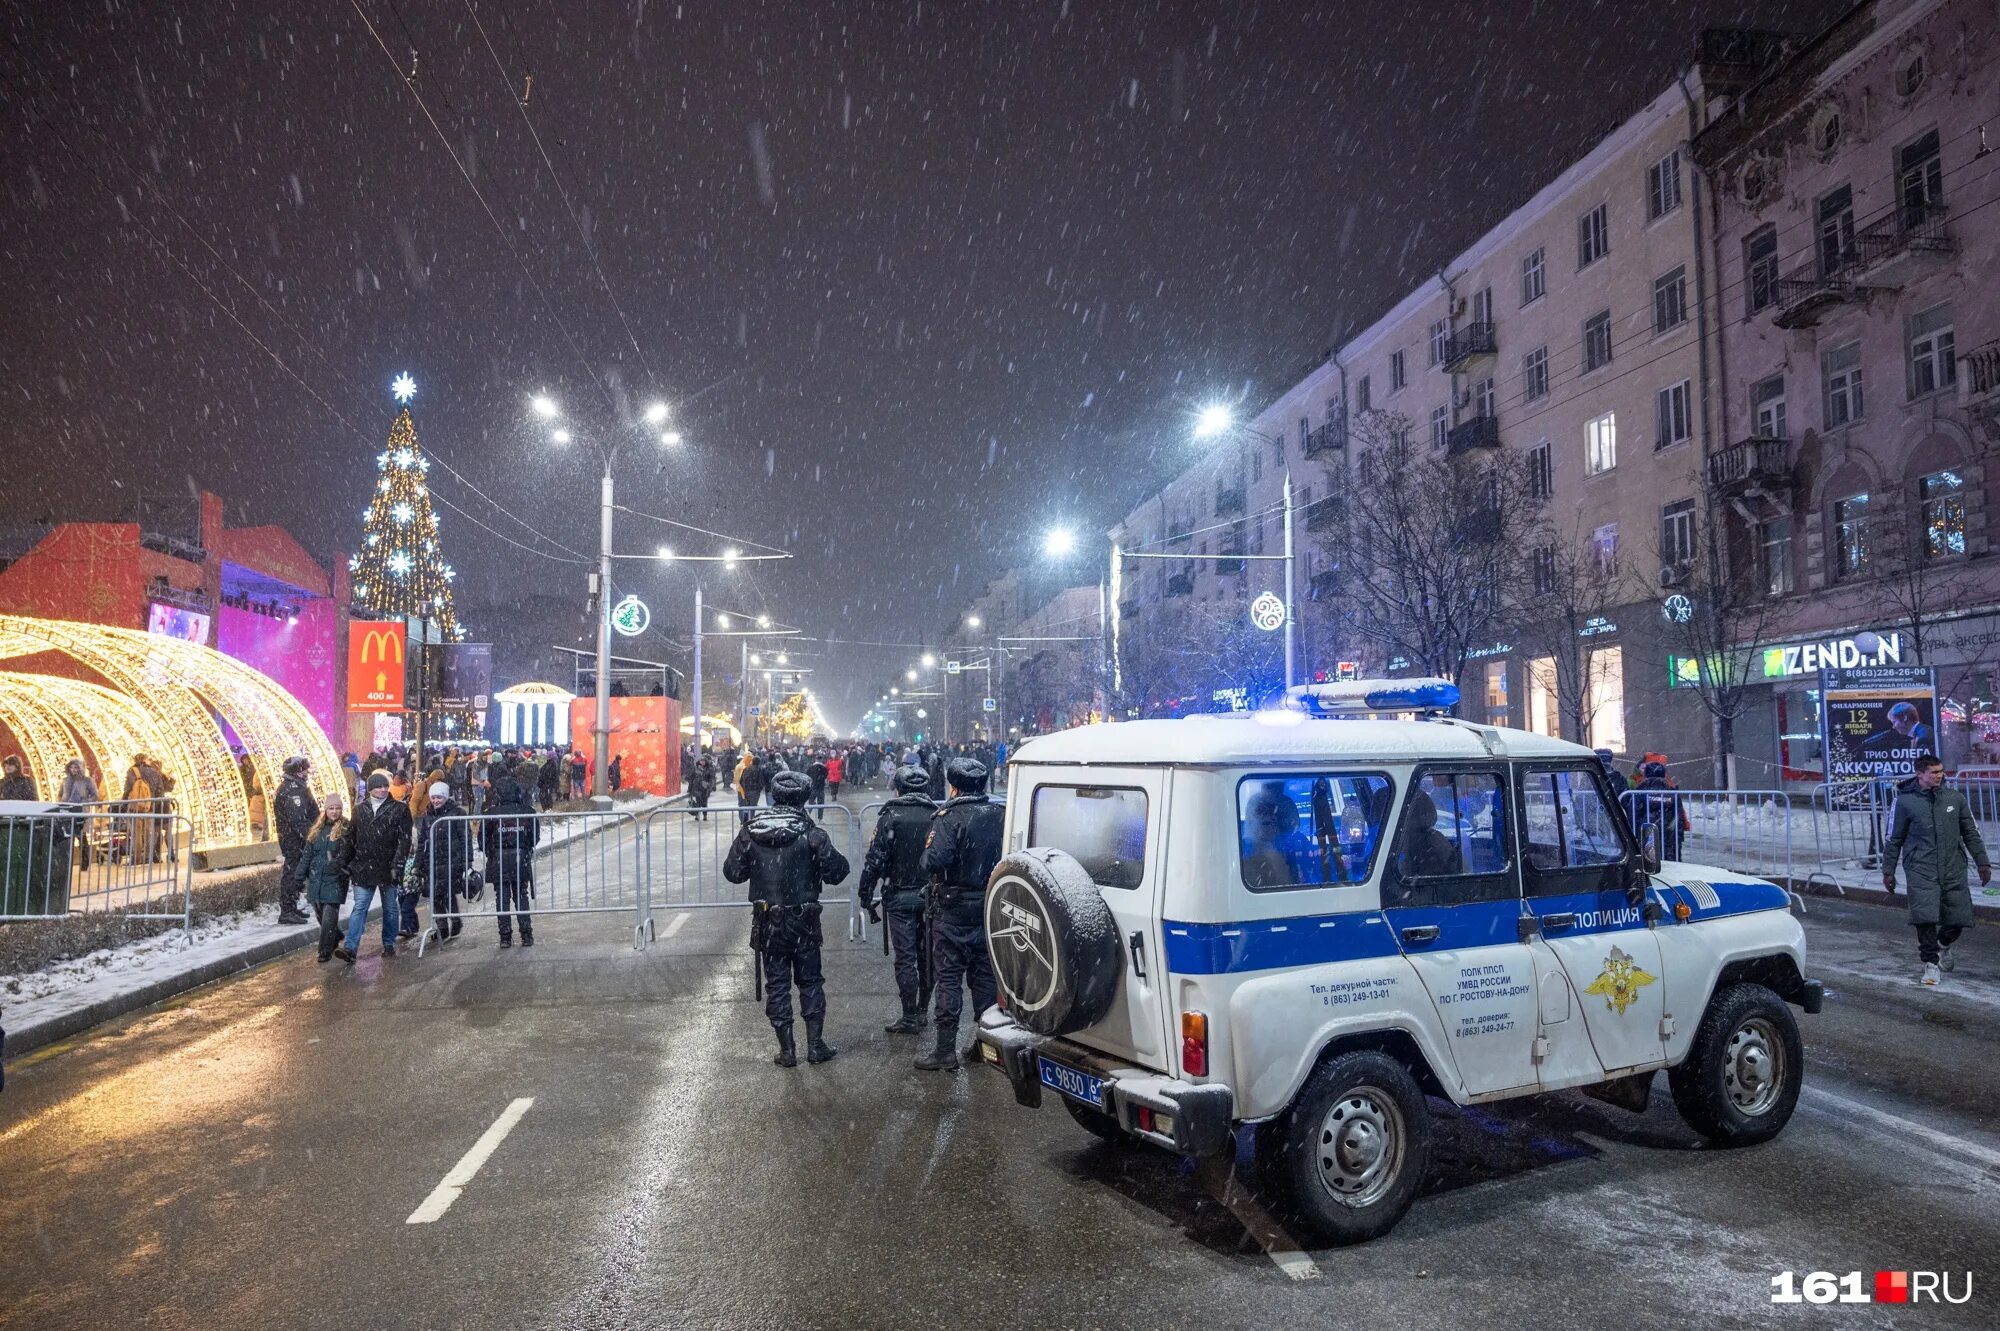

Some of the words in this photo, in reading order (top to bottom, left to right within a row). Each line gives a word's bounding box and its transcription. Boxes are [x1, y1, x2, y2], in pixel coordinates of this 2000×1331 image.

[1785, 633, 1900, 674] ZENDN
[1846, 668, 1926, 678] 8(863)226-26-00
[367, 692, 384, 701] 400
[1849, 709, 1868, 723] 12
[1864, 750, 1888, 759] ТРИО
[1891, 748, 1931, 759] ОЛЕГА
[1574, 907, 1640, 929] ПОЛИЦИЯ
[1461, 968, 1482, 977] ПОЛК
[1483, 964, 1505, 975] ППСП
[1310, 984, 1329, 993] Тел.
[1330, 978, 1371, 993] дежурной
[1372, 977, 1399, 986] части:
[1457, 980, 1479, 990] УМВД
[1480, 976, 1512, 987] РОССИИ
[1323, 996, 1329, 1006] 8
[1331, 994, 1351, 1006] (863)
[1353, 989, 1390, 1002] 249-13-01
[1440, 995, 1451, 1005] ПО
[1453, 994, 1459, 1003] Г.
[1460, 985, 1530, 1002] РОСТОВУ-НА-ДОНУ
[1461, 1017, 1476, 1025] тел.
[1477, 1012, 1511, 1024] доверия:
[1456, 1029, 1461, 1037] 8
[1462, 1027, 1480, 1038] (863)
[1481, 1021, 1515, 1034] 249-24-77
[1055, 1067, 1084, 1096] 9830
